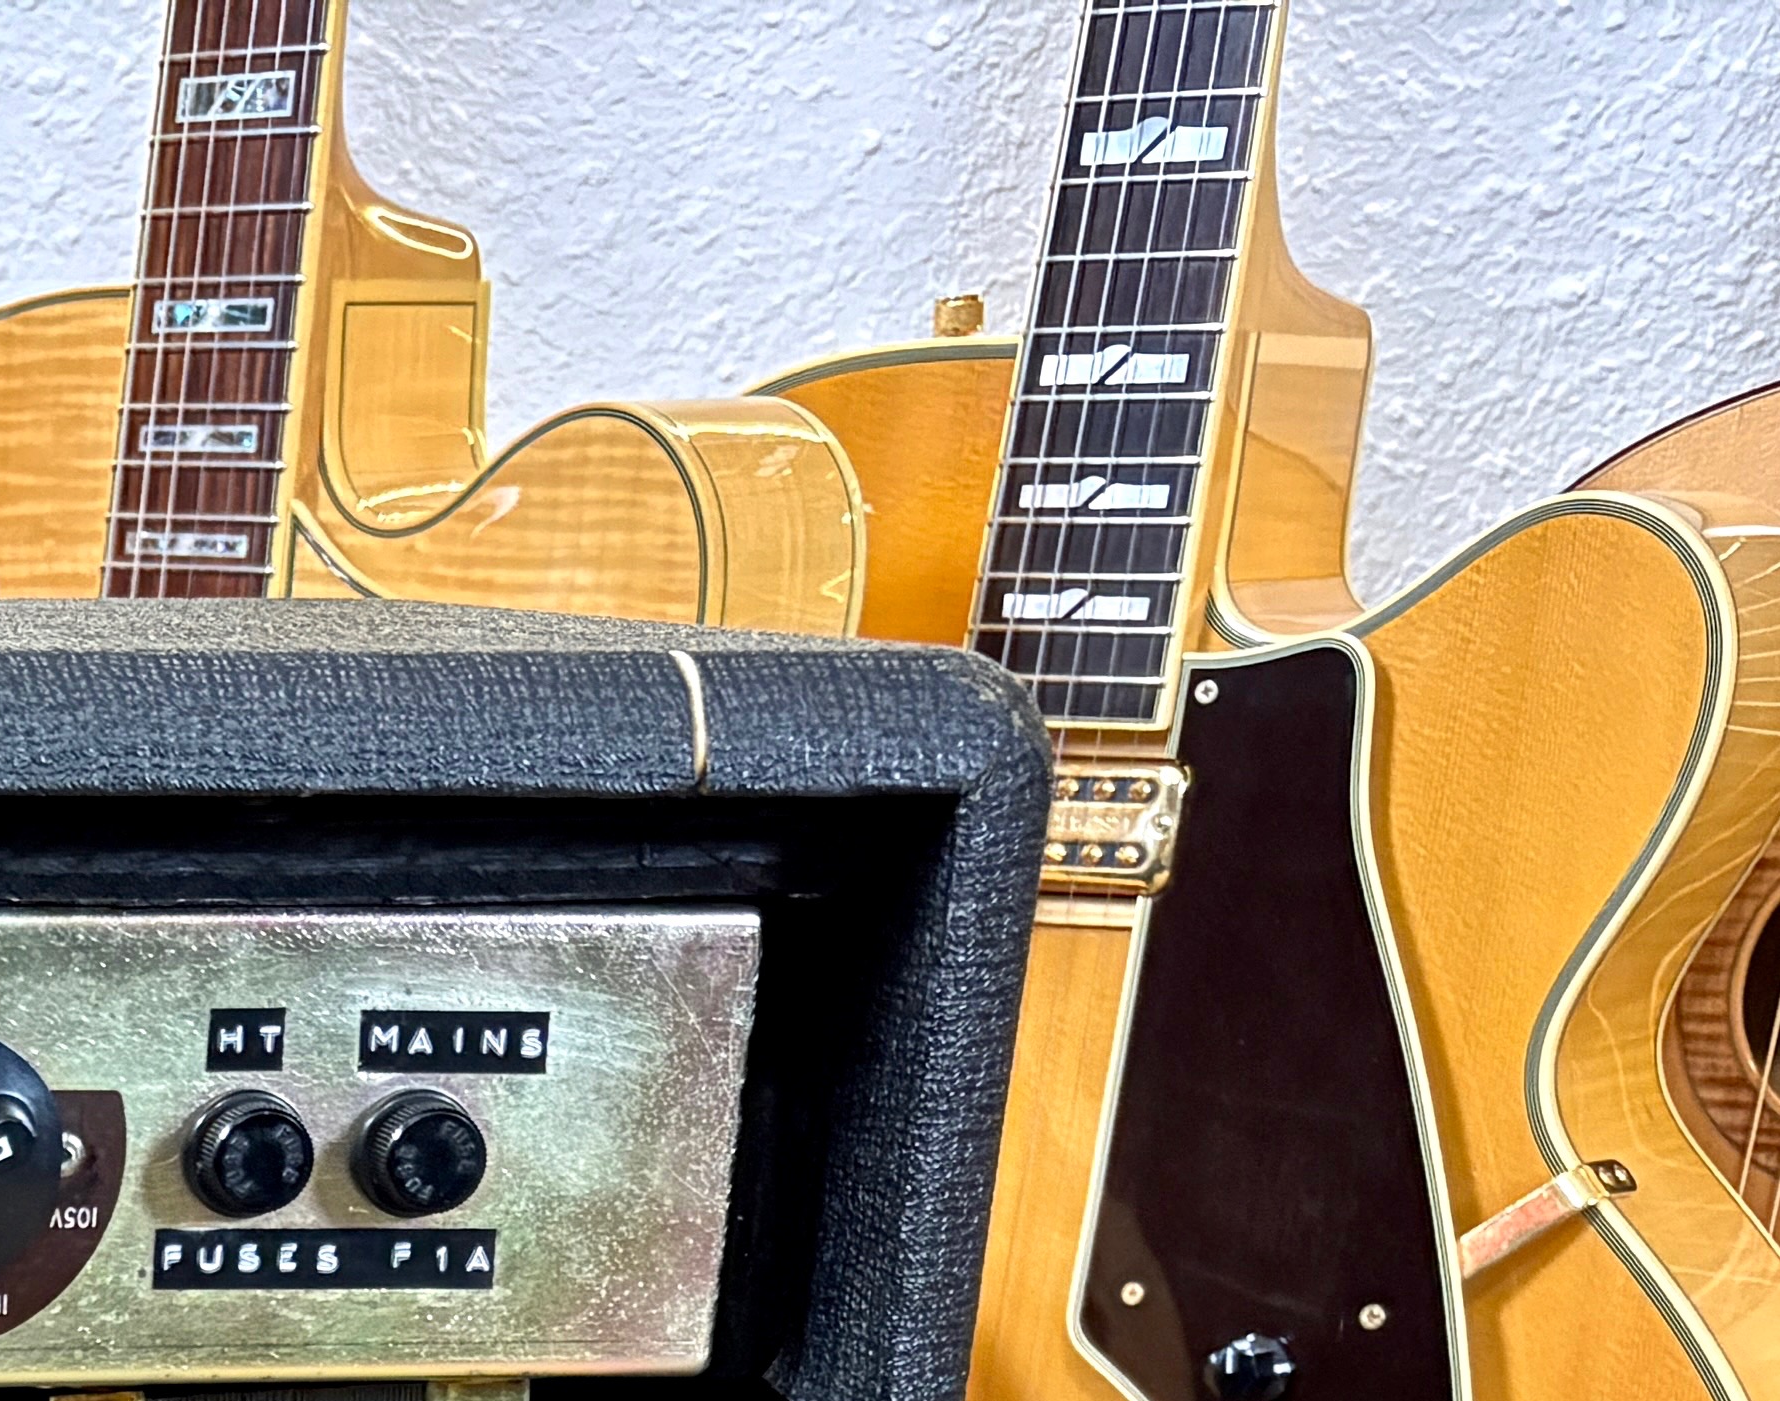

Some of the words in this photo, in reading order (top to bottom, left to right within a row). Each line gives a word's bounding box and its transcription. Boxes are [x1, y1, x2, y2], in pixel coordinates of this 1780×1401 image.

[218, 1024, 282, 1054] HT
[370, 1024, 542, 1059] MAINS
[49, 1206, 98, 1229] 105V
[162, 1242, 339, 1274] FUSES
